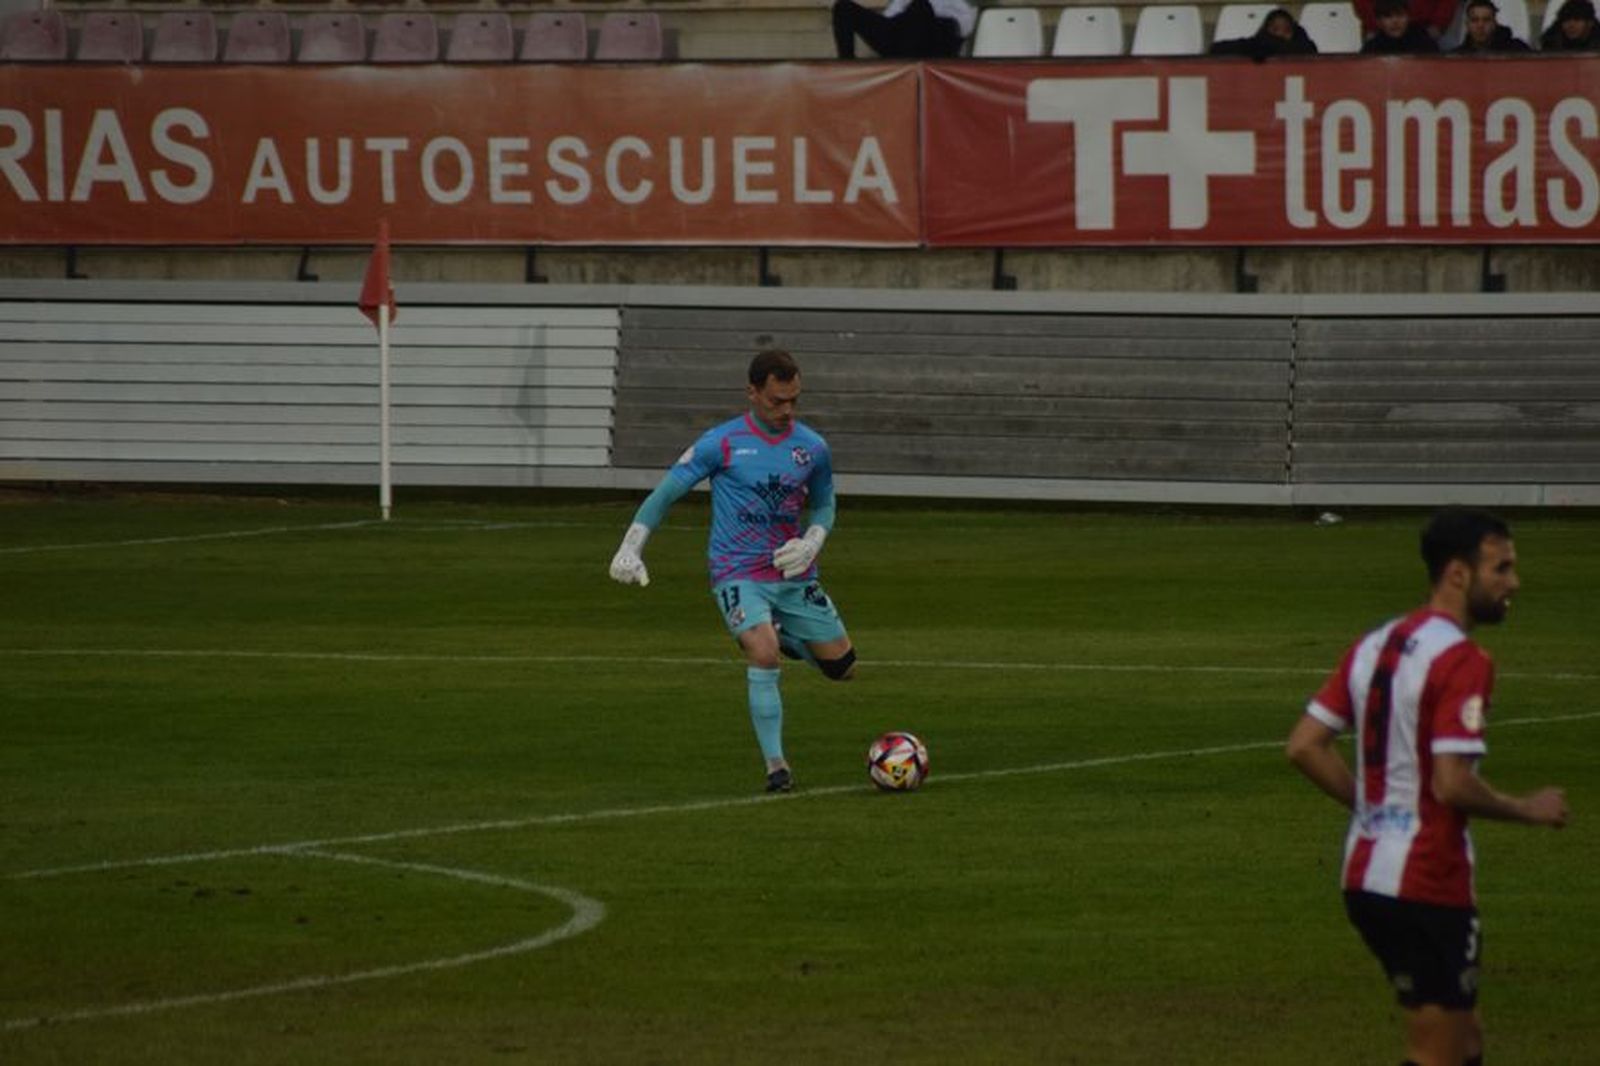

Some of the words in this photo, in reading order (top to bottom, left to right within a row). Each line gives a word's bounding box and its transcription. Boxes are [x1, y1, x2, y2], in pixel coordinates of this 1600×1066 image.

[0, 108, 213, 205] RIAS
[241, 135, 900, 206] AUTOESCUELA
[1275, 75, 1600, 229] temas
[721, 586, 740, 612] 13
